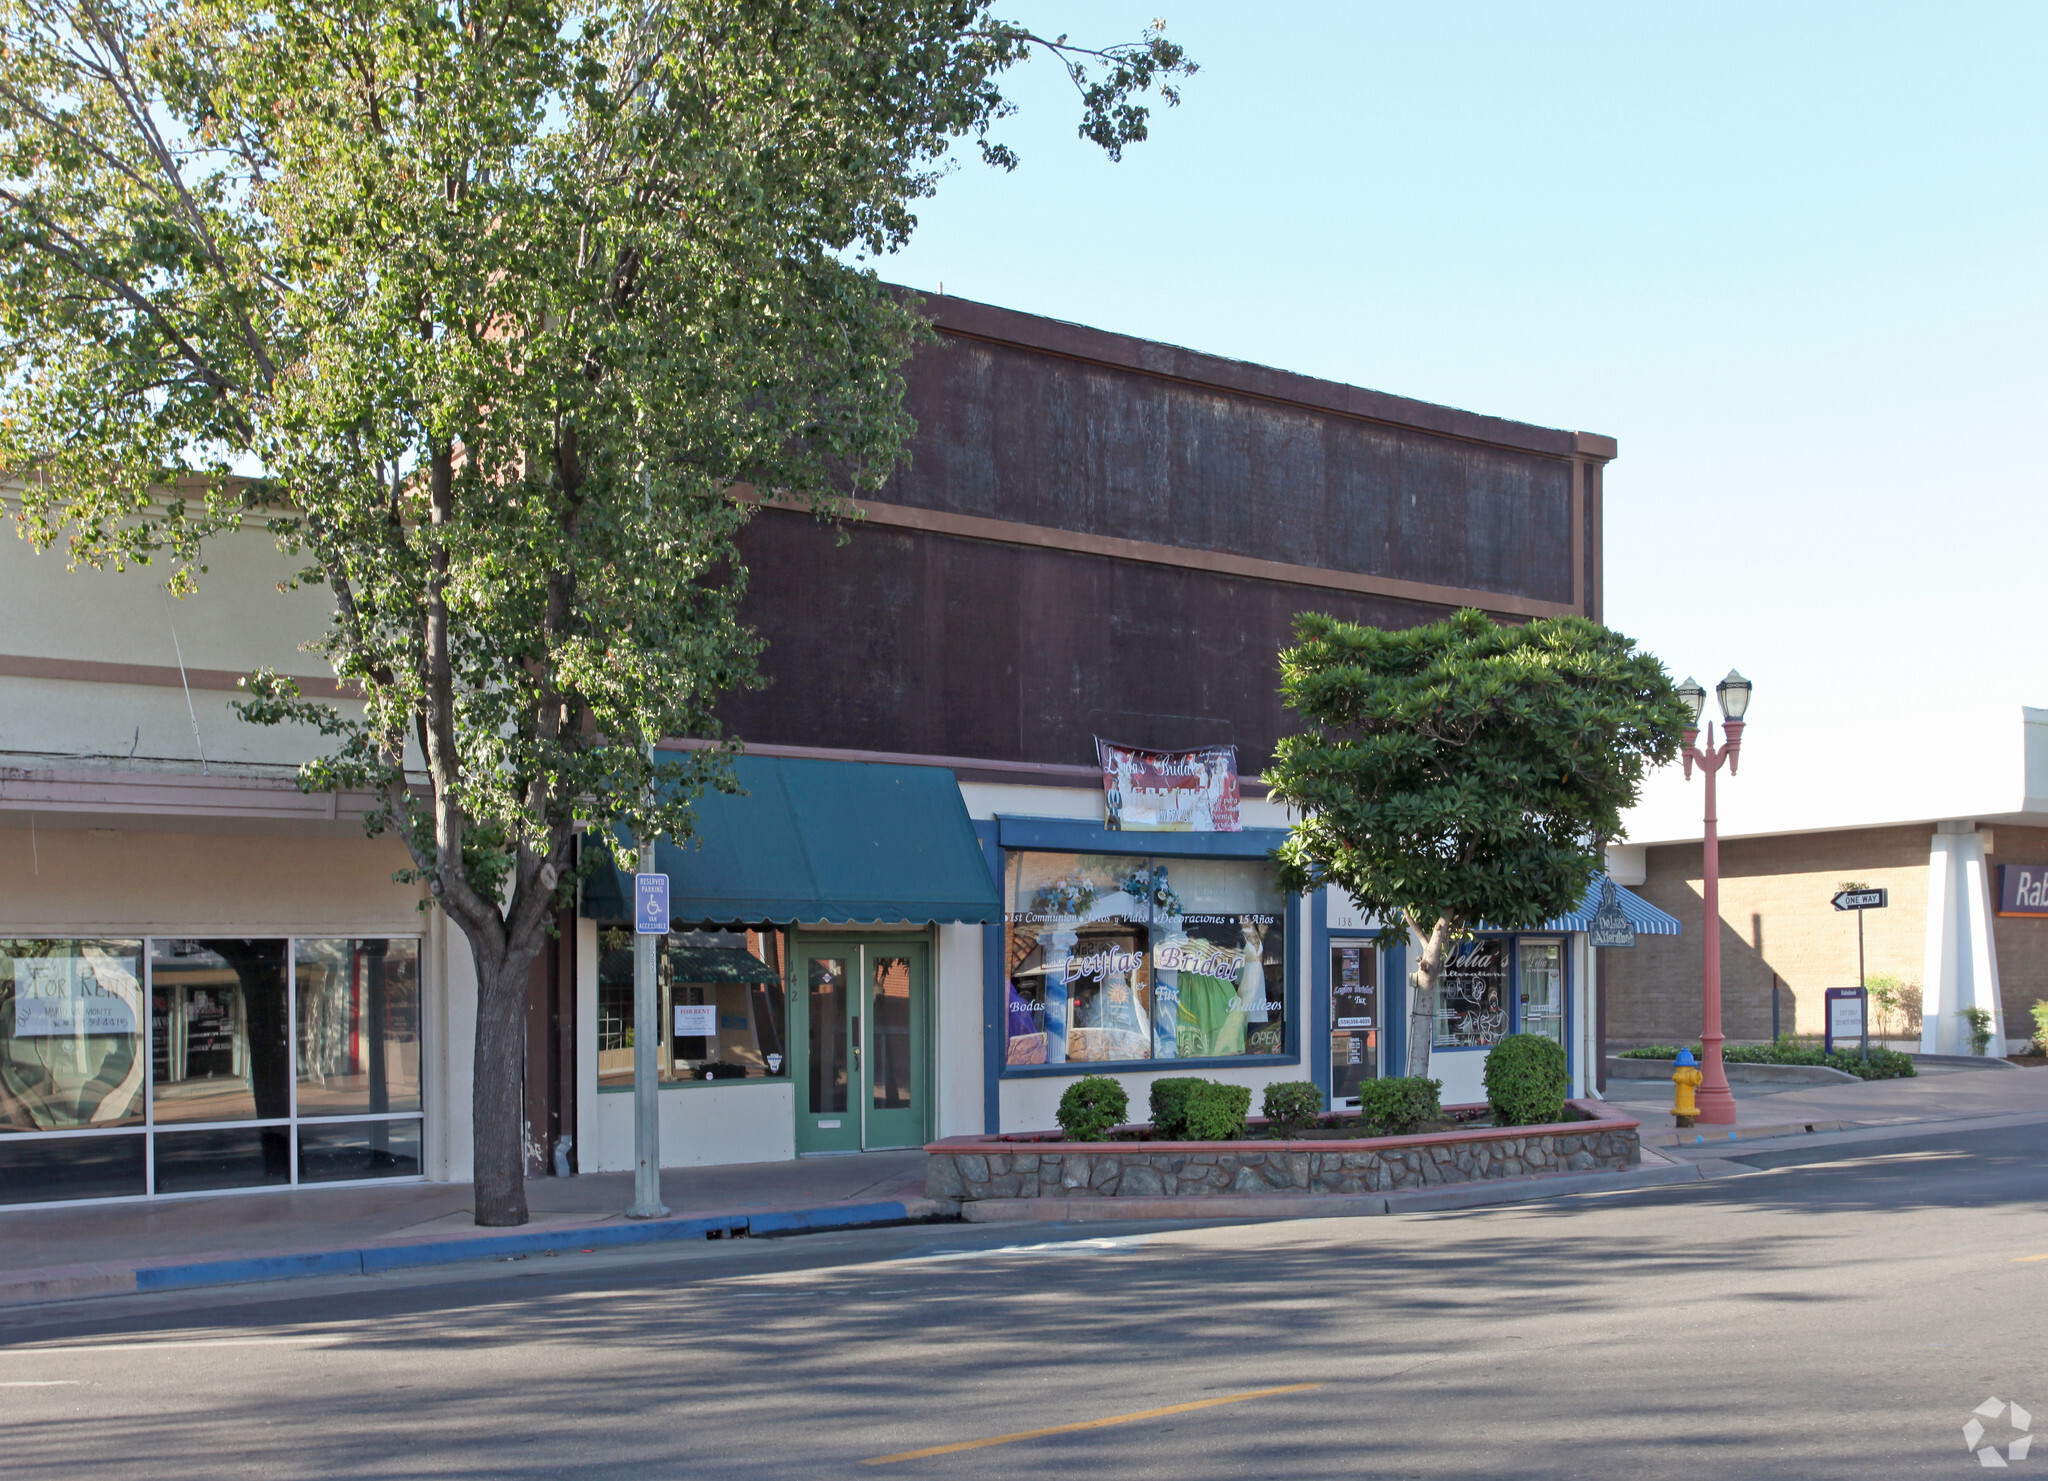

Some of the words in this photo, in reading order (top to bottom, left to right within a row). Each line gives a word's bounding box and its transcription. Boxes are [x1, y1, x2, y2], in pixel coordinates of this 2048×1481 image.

[1845, 896, 1860, 904] ONE
[1861, 894, 1878, 903] WAY
[1025, 912, 1077, 923] Communion
[1121, 913, 1148, 923] Video
[1157, 914, 1226, 925] Decoraciones
[1238, 915, 1249, 924] 15
[1251, 914, 1274, 924] Años
[1338, 917, 1353, 927] 138
[638, 922, 667, 930] ACCESSIBLE
[1060, 945, 1144, 985] Leylas
[1160, 946, 1245, 981] Bridal
[29, 966, 67, 999] FOR
[1009, 999, 1046, 1012] Bodas
[1354, 995, 1367, 1005] Tux
[1251, 1031, 1282, 1045] OPEN
